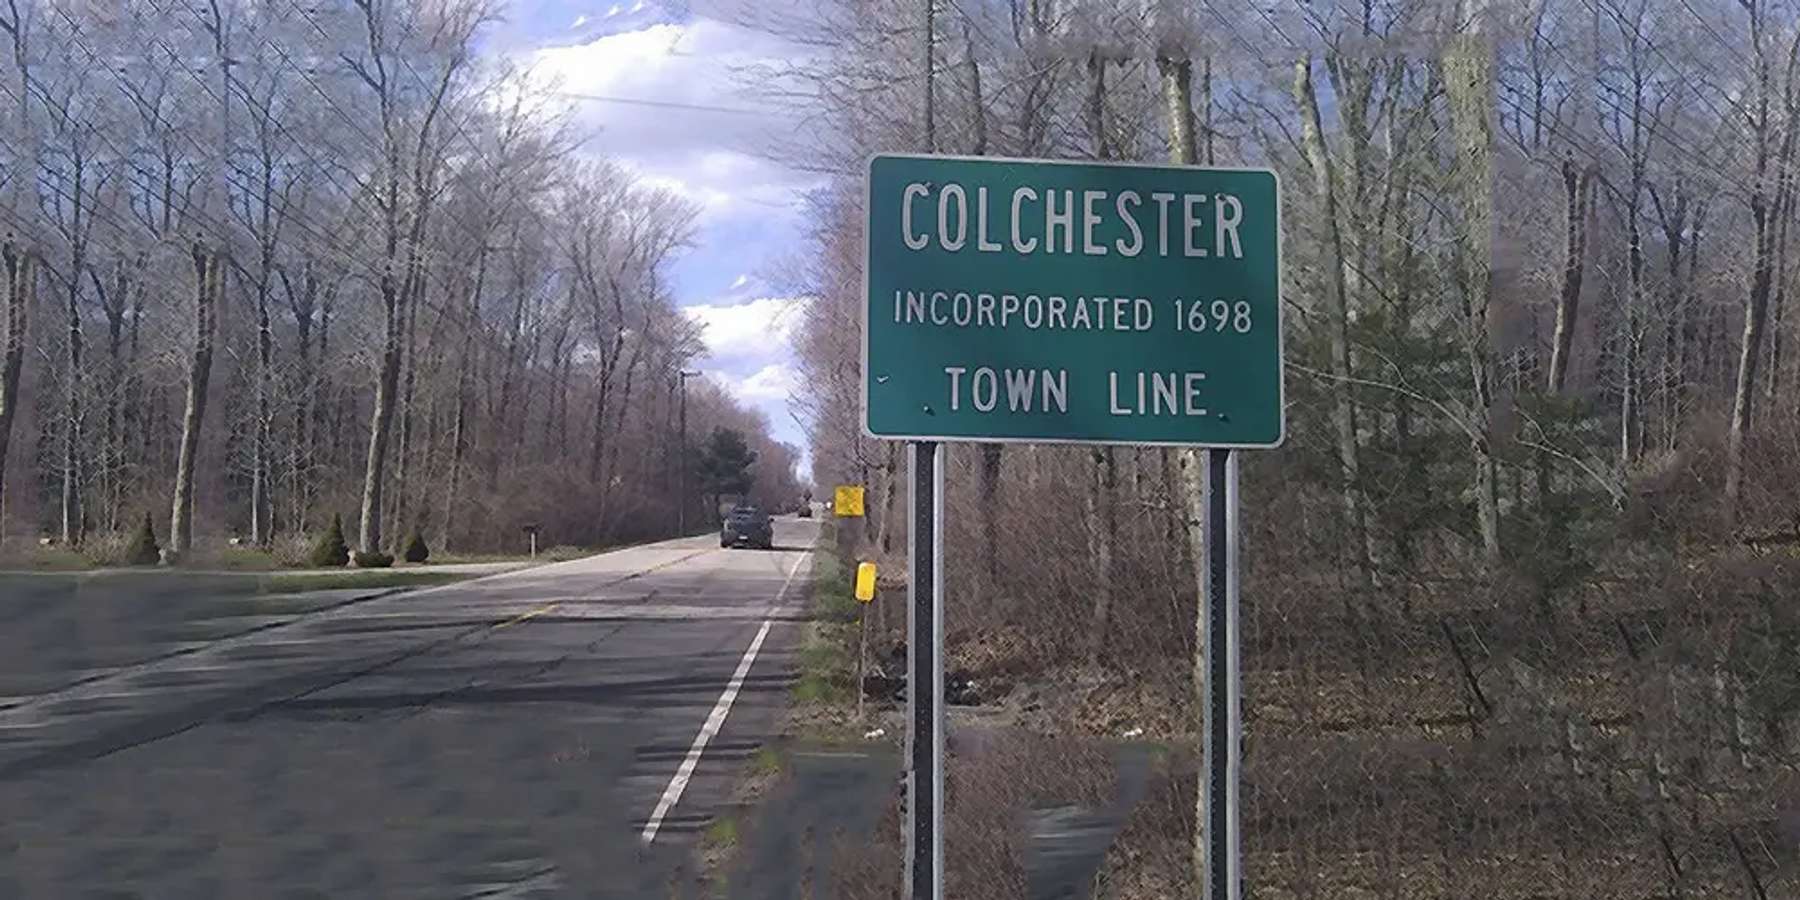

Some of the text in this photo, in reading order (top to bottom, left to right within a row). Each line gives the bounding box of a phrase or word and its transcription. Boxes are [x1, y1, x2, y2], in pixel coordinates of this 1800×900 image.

[902, 182, 1244, 258] COLCHESTER
[893, 290, 1252, 333] INCORPORATED 1698
[944, 367, 1208, 416] TOWN LINE
